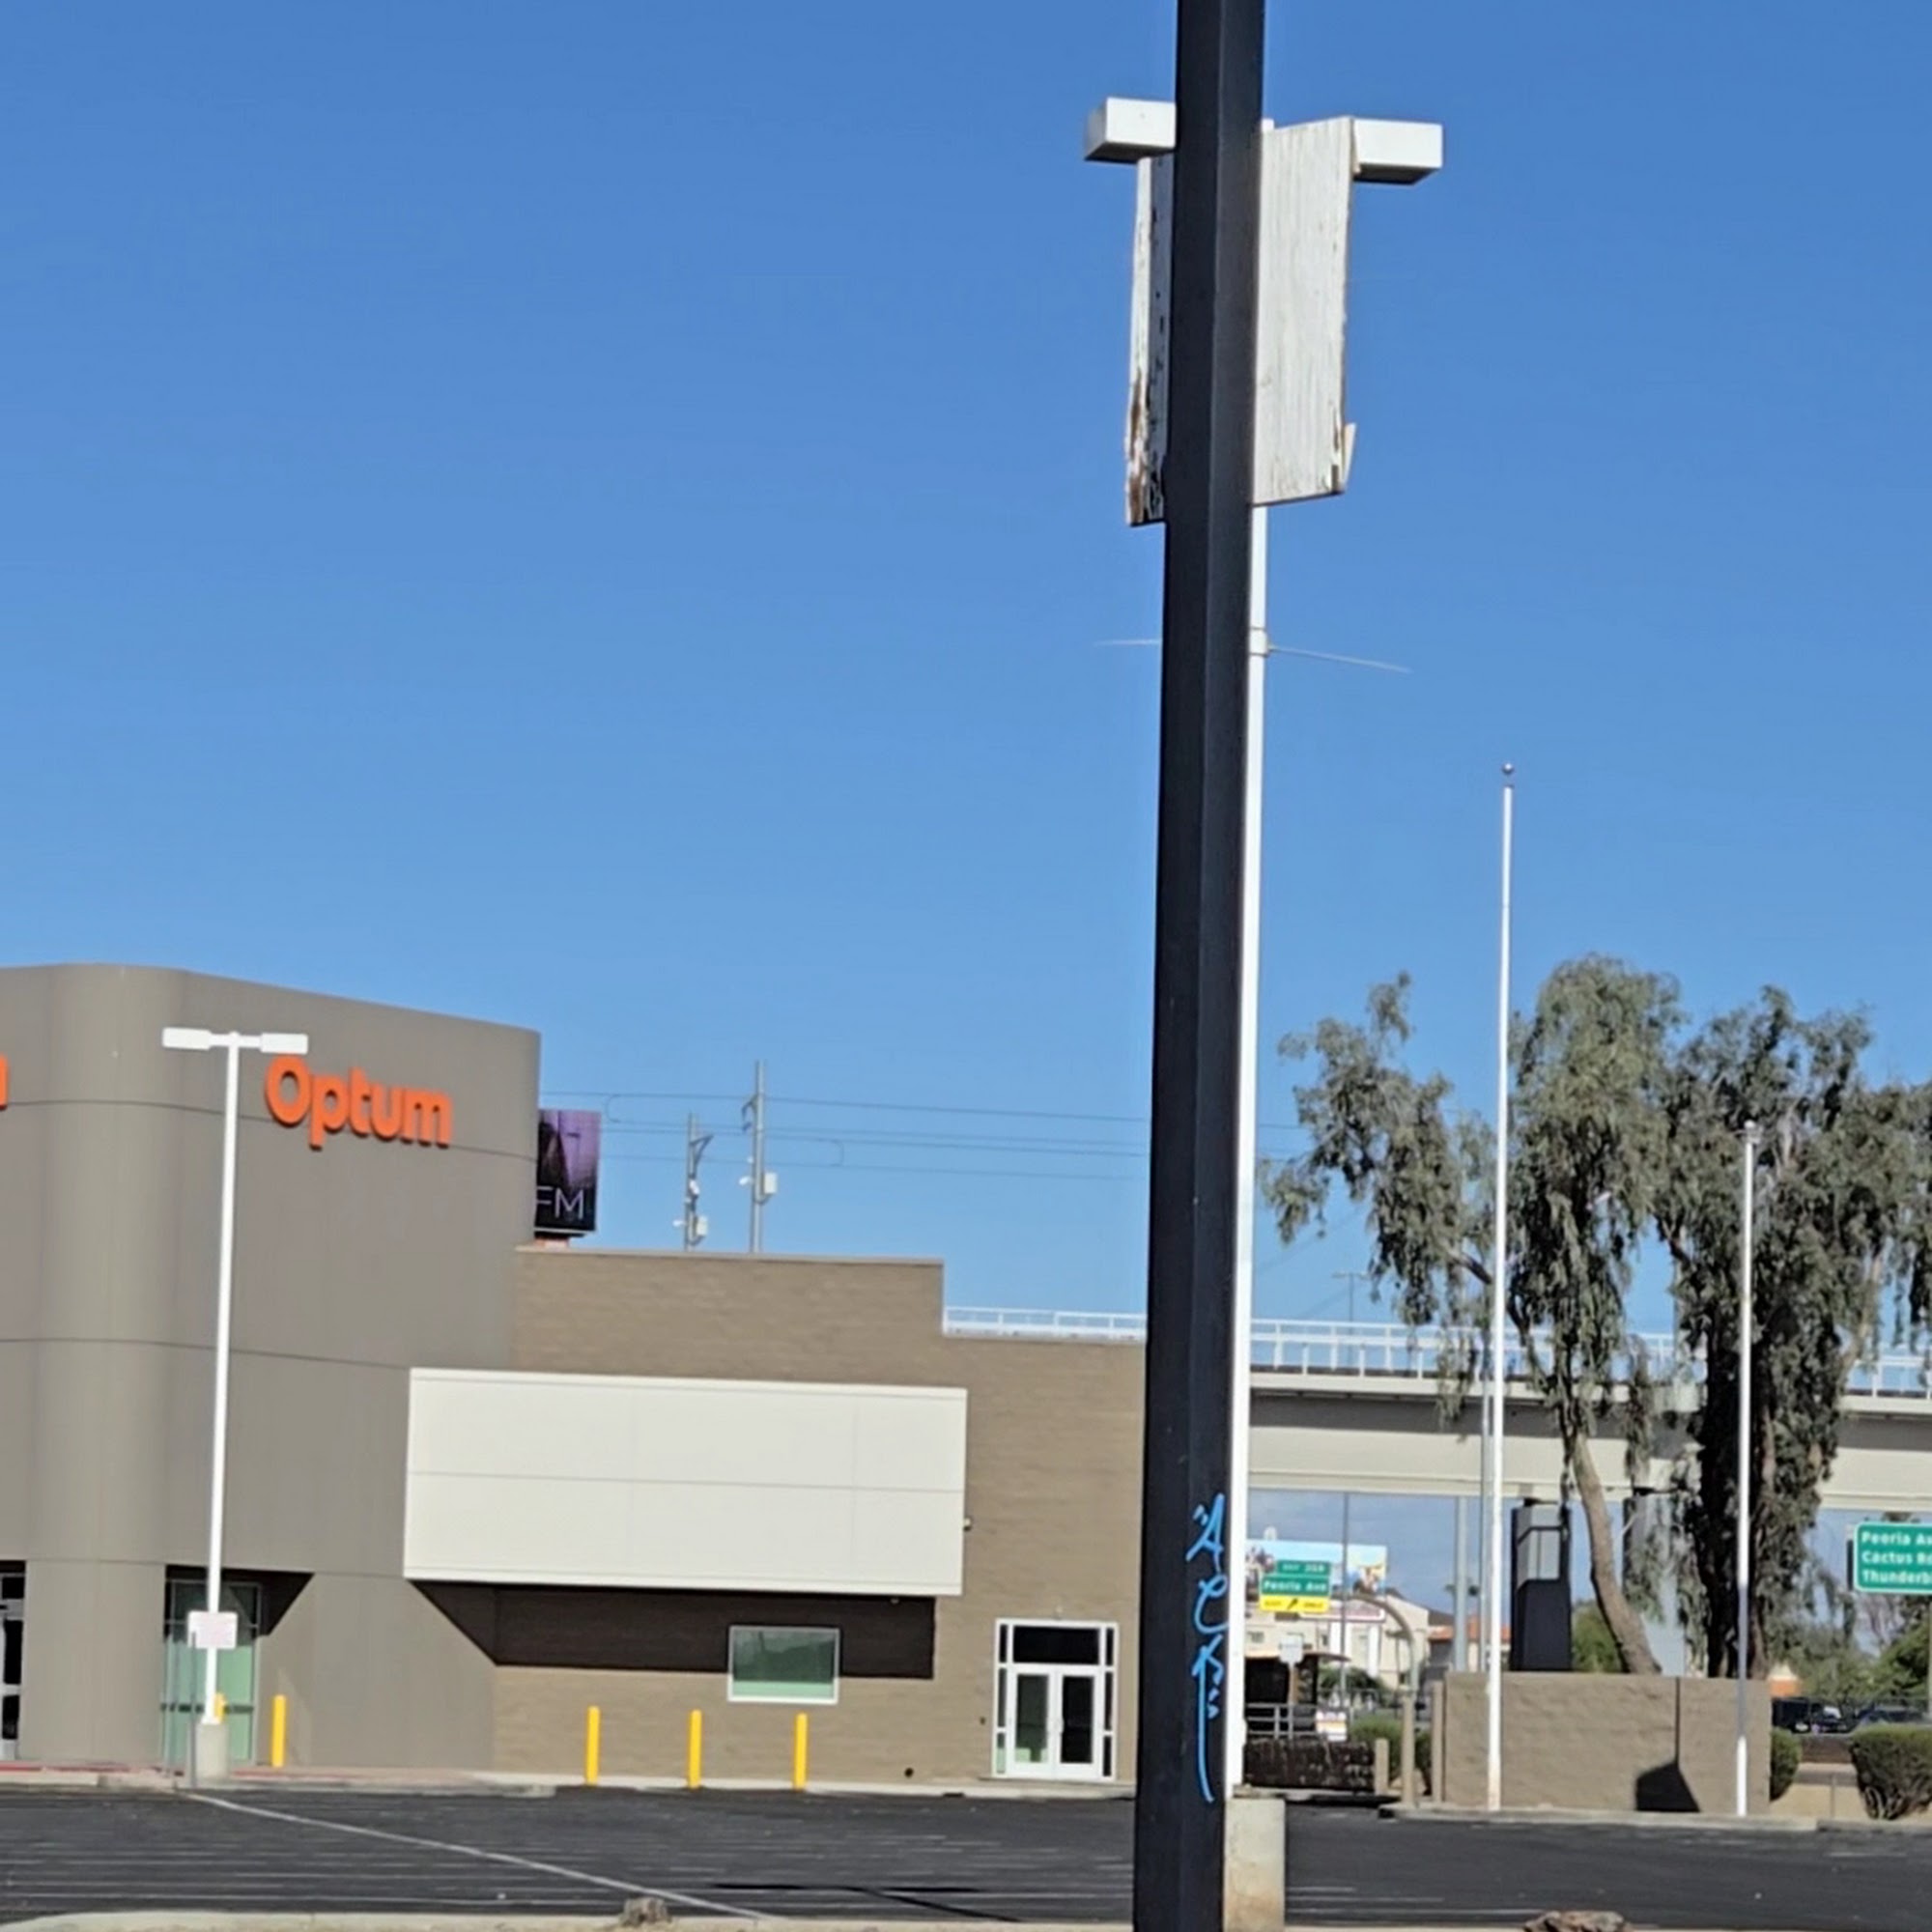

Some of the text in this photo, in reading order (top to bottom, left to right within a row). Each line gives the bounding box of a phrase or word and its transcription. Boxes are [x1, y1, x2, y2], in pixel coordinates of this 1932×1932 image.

[266, 1054, 452, 1151] Optum
[1861, 1531, 1911, 1546] Peoria
[1861, 1550, 1913, 1565] Cactus
